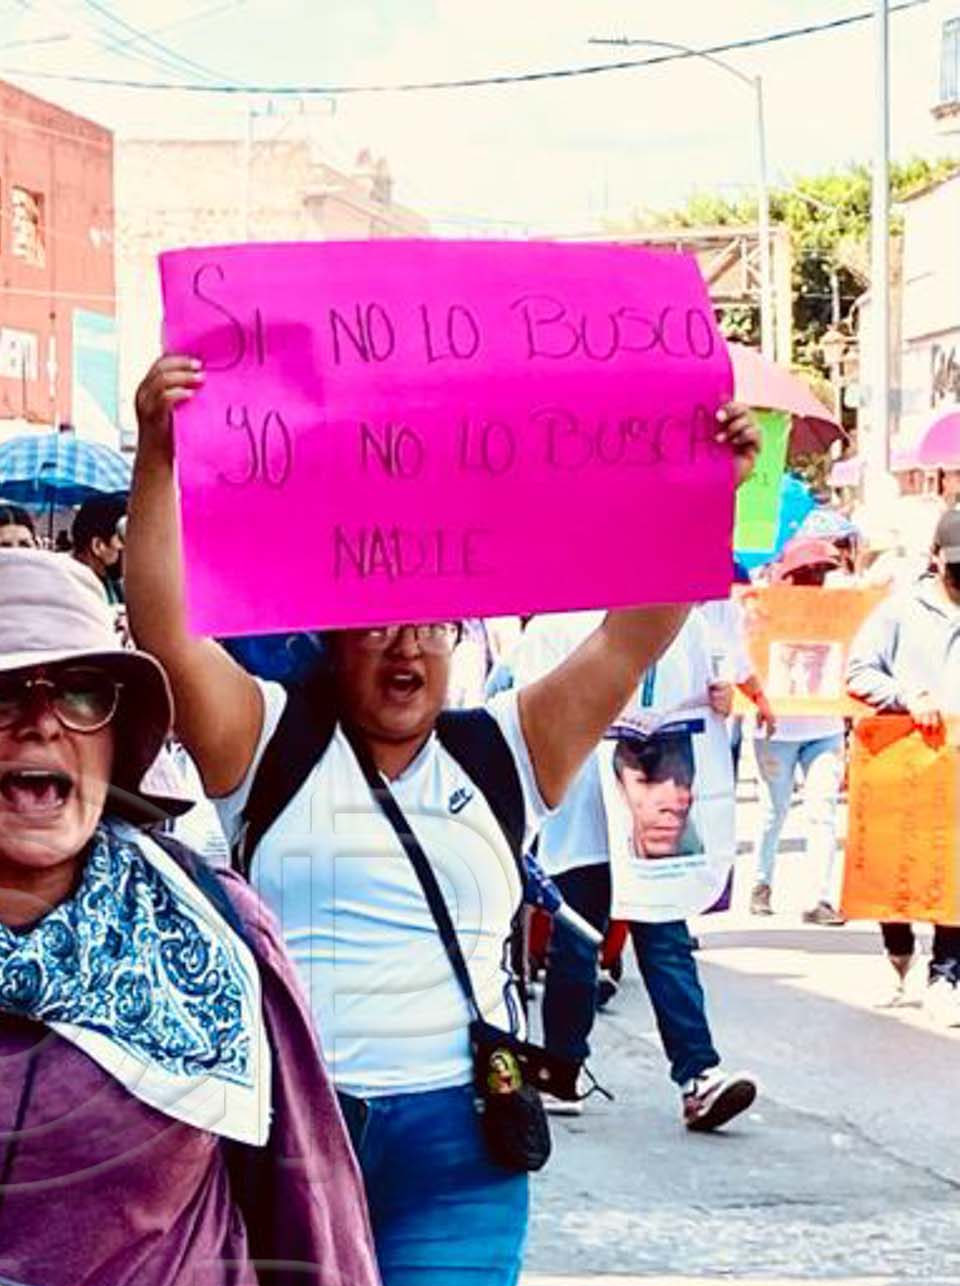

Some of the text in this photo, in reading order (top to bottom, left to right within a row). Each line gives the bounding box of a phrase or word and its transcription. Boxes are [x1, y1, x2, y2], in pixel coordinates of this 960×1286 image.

[193, 264, 715, 372] SI NO LO BUSCO
[359, 422, 425, 479] NO
[460, 416, 516, 476] LO
[529, 405, 727, 470] BUSCA
[333, 524, 493, 583] NADIE
